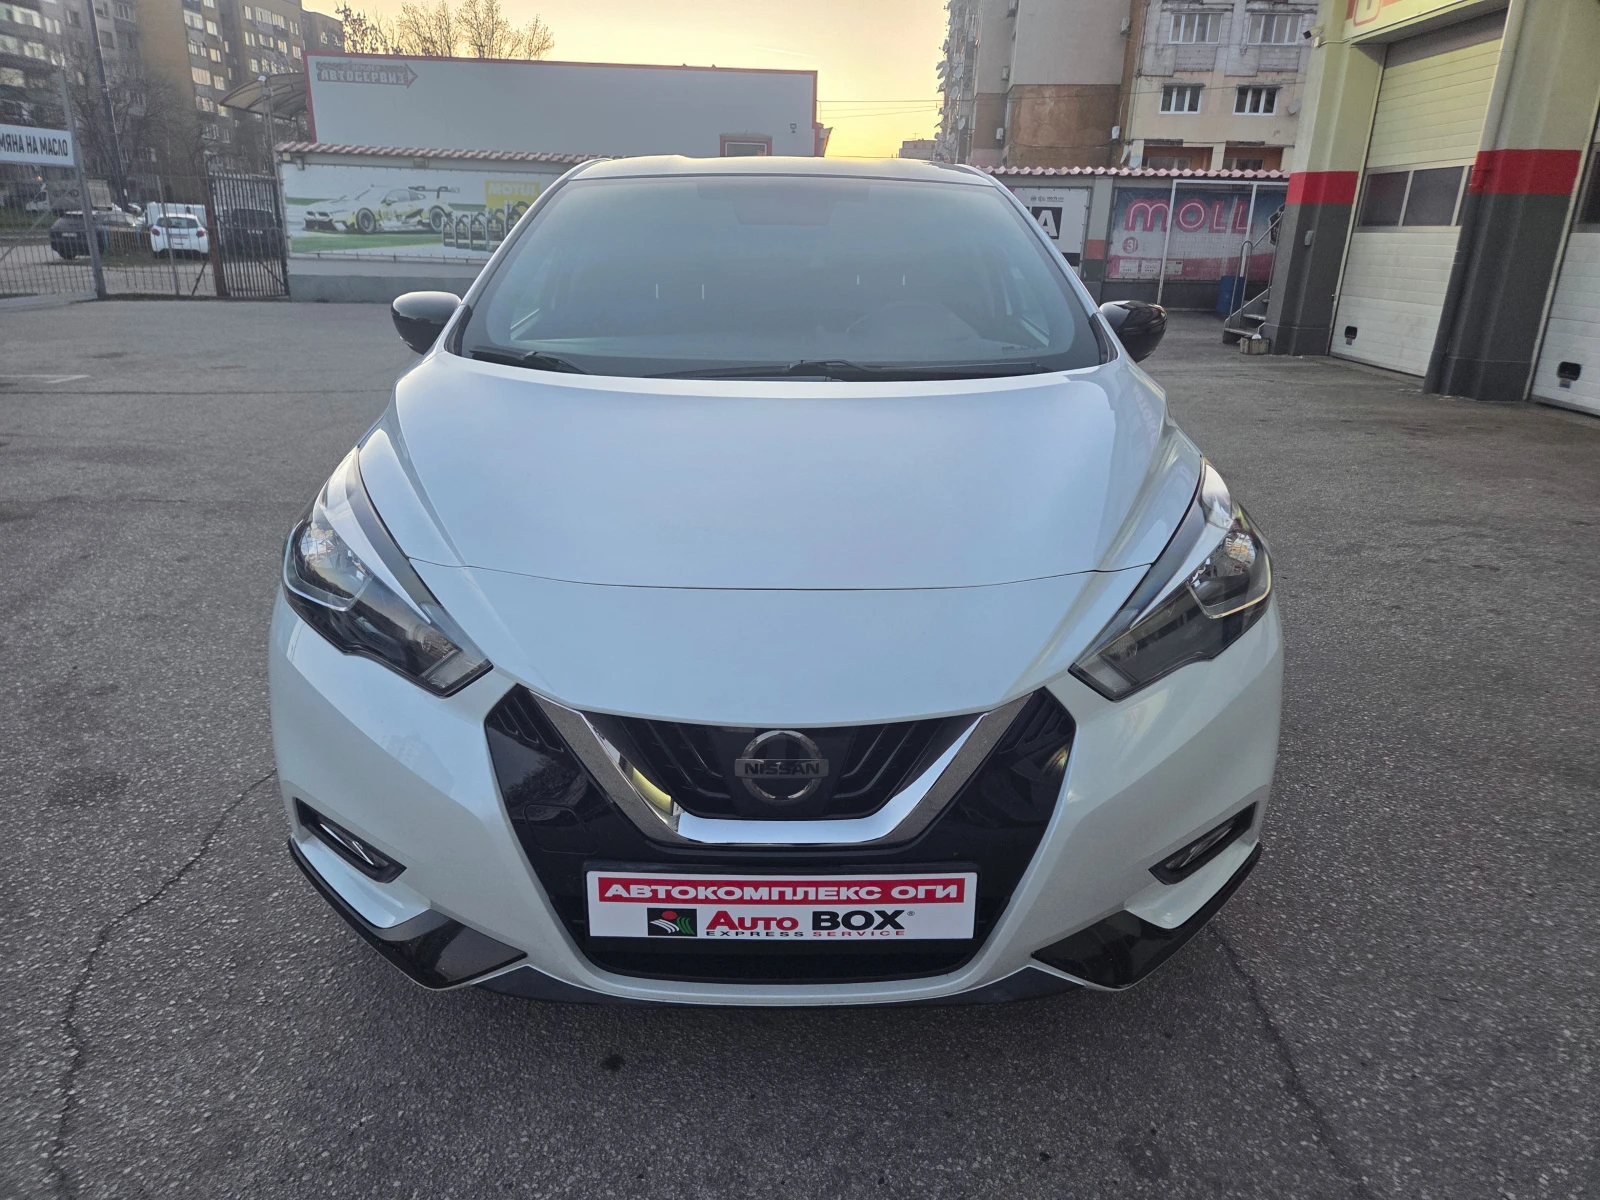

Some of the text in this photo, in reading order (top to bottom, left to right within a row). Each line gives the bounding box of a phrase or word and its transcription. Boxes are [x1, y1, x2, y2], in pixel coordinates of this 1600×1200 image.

[320, 69, 405, 83] АВТОСЕРВИЗ
[25, 134, 39, 154] НА
[39, 136, 69, 157] МАСЛО
[487, 182, 537, 196] MOTUL
[744, 762, 820, 775] NISSAN
[604, 884, 958, 901] АВТОКОМПЛЕКС ОГИ
[811, 909, 905, 931] BOX
